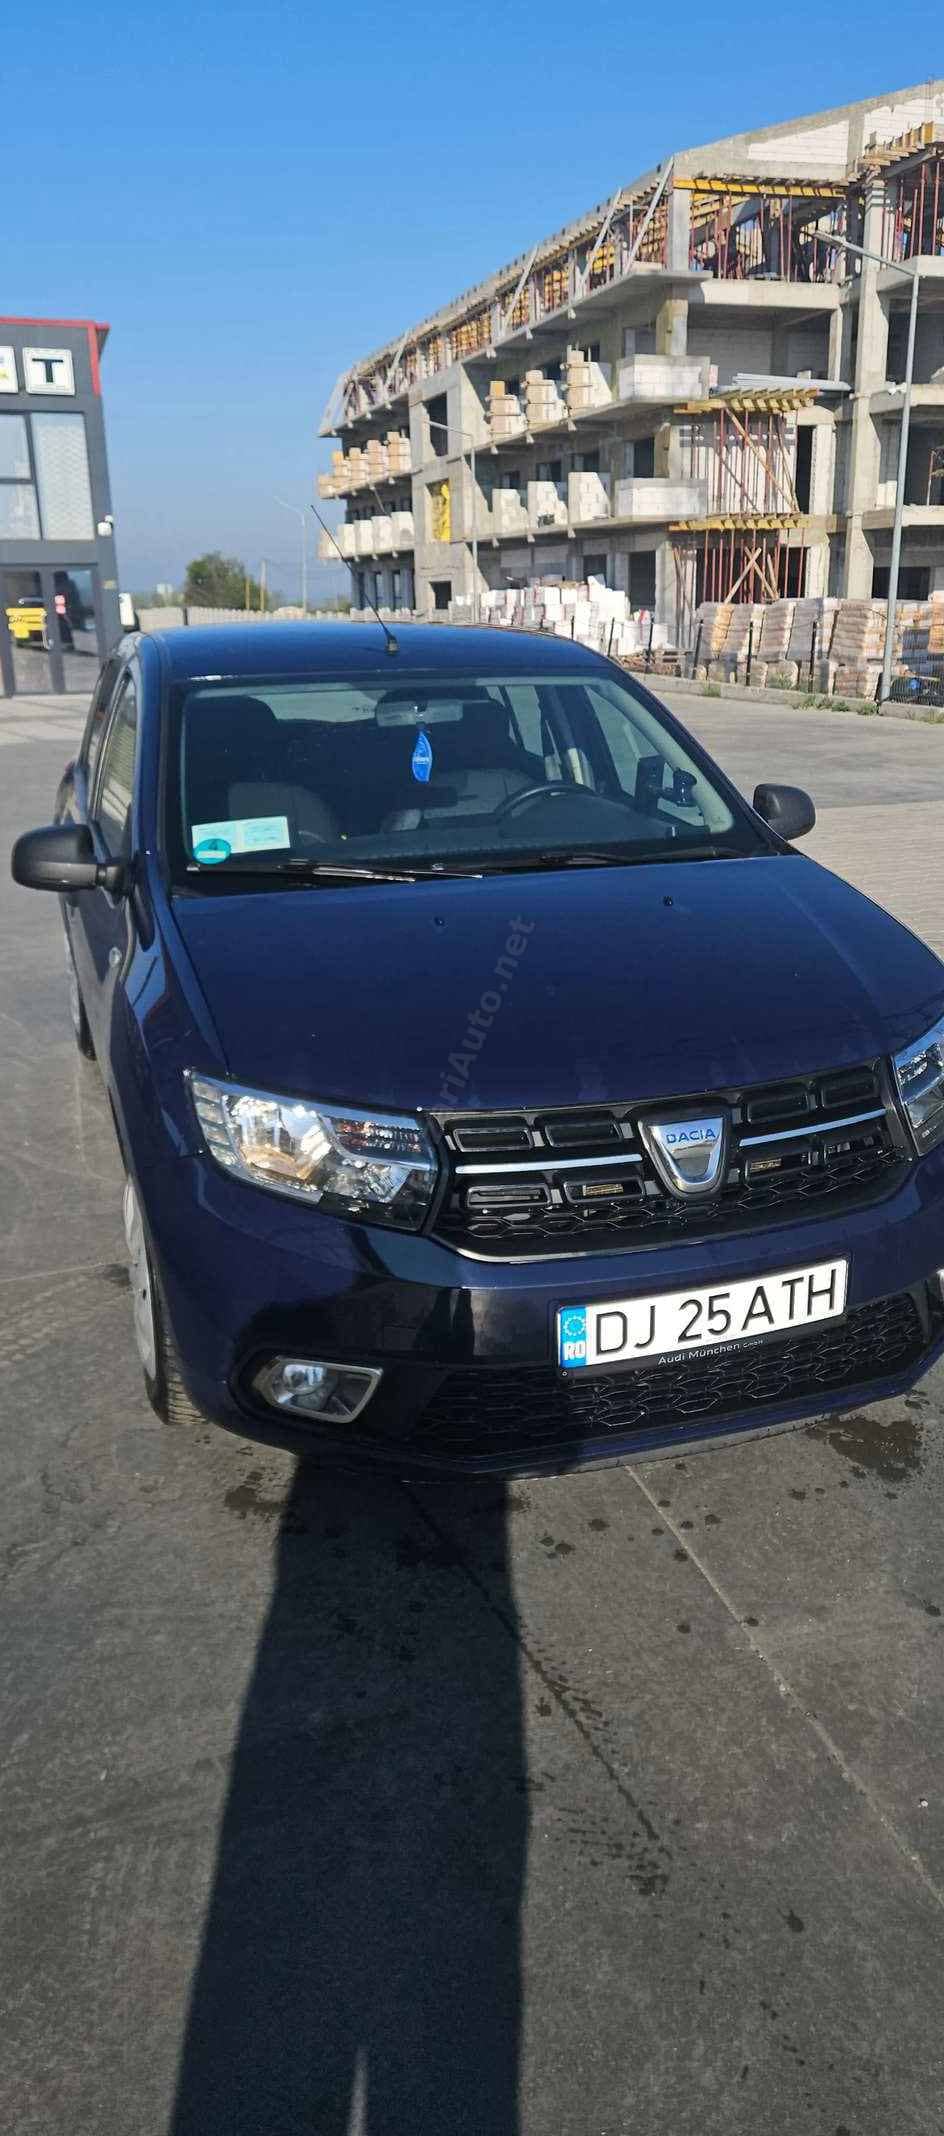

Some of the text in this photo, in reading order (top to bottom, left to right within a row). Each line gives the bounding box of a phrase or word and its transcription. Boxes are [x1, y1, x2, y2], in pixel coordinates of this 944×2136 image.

[32, 358, 64, 383] T
[666, 1128, 716, 1144] DACIA
[596, 1269, 837, 1356] DJ 25 ATH
[563, 1341, 586, 1361] RO
[658, 1353, 685, 1365] Audi
[688, 1342, 740, 1359] München
